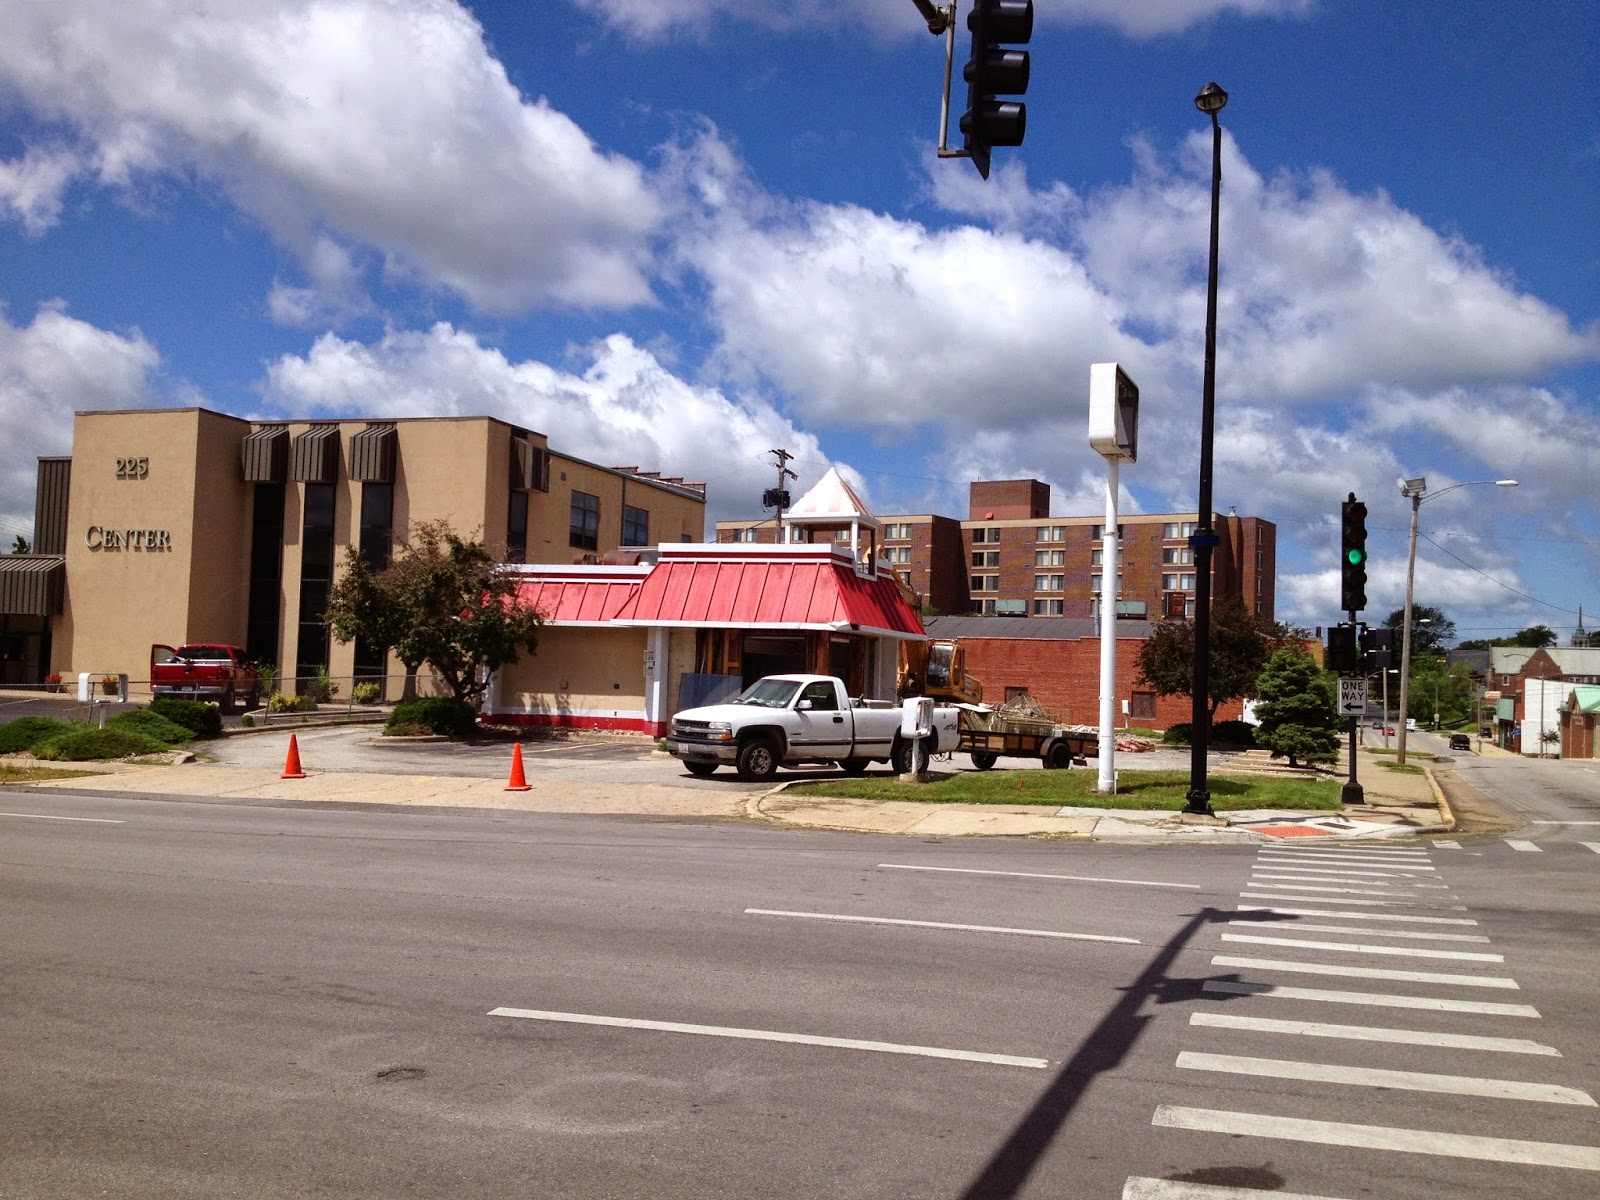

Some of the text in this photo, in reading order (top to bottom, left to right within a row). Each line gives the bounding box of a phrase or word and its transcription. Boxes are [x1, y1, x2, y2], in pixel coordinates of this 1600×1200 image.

[116, 457, 149, 478] 225
[85, 525, 171, 550] CENTER
[1342, 681, 1364, 691] ONE
[1341, 691, 1365, 701] WAY
